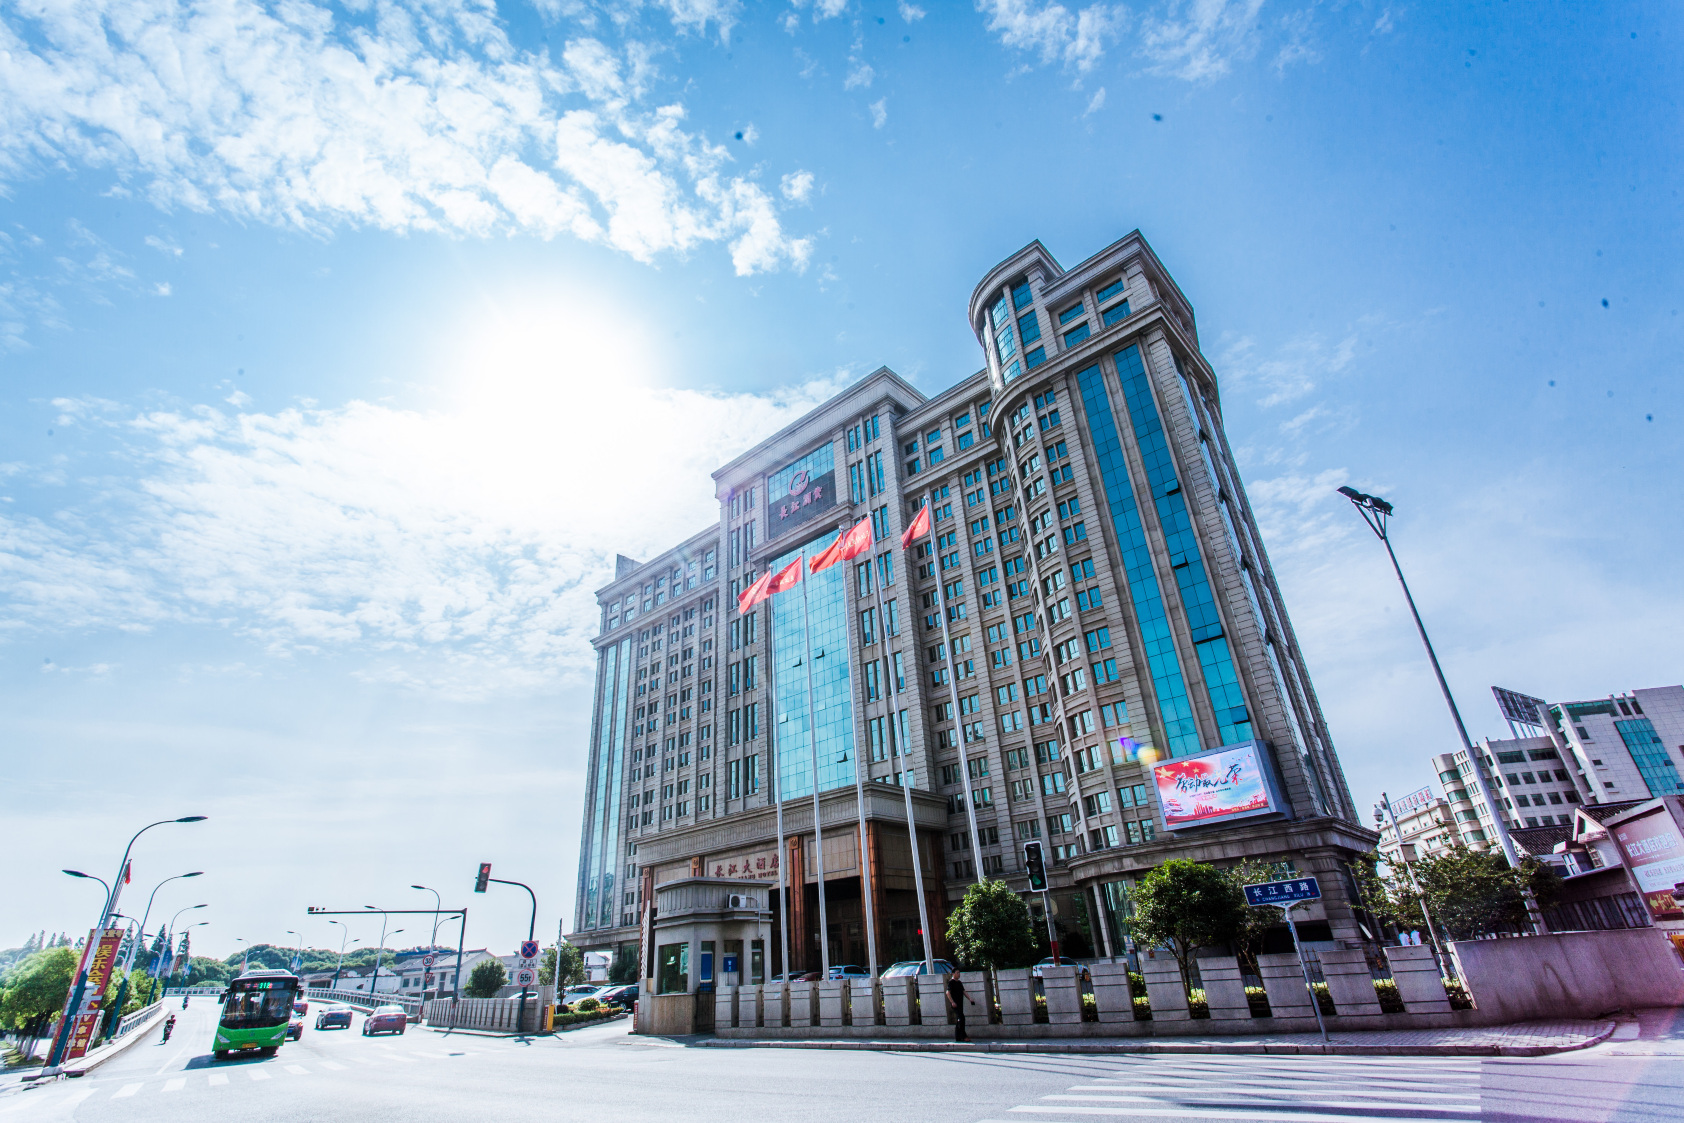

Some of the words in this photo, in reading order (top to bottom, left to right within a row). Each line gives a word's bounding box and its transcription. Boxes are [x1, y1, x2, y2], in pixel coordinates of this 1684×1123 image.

[1175, 763, 1242, 797] 劳动最光荣
[1253, 882, 1309, 896] 长江西路
[520, 973, 532, 982] 55t
